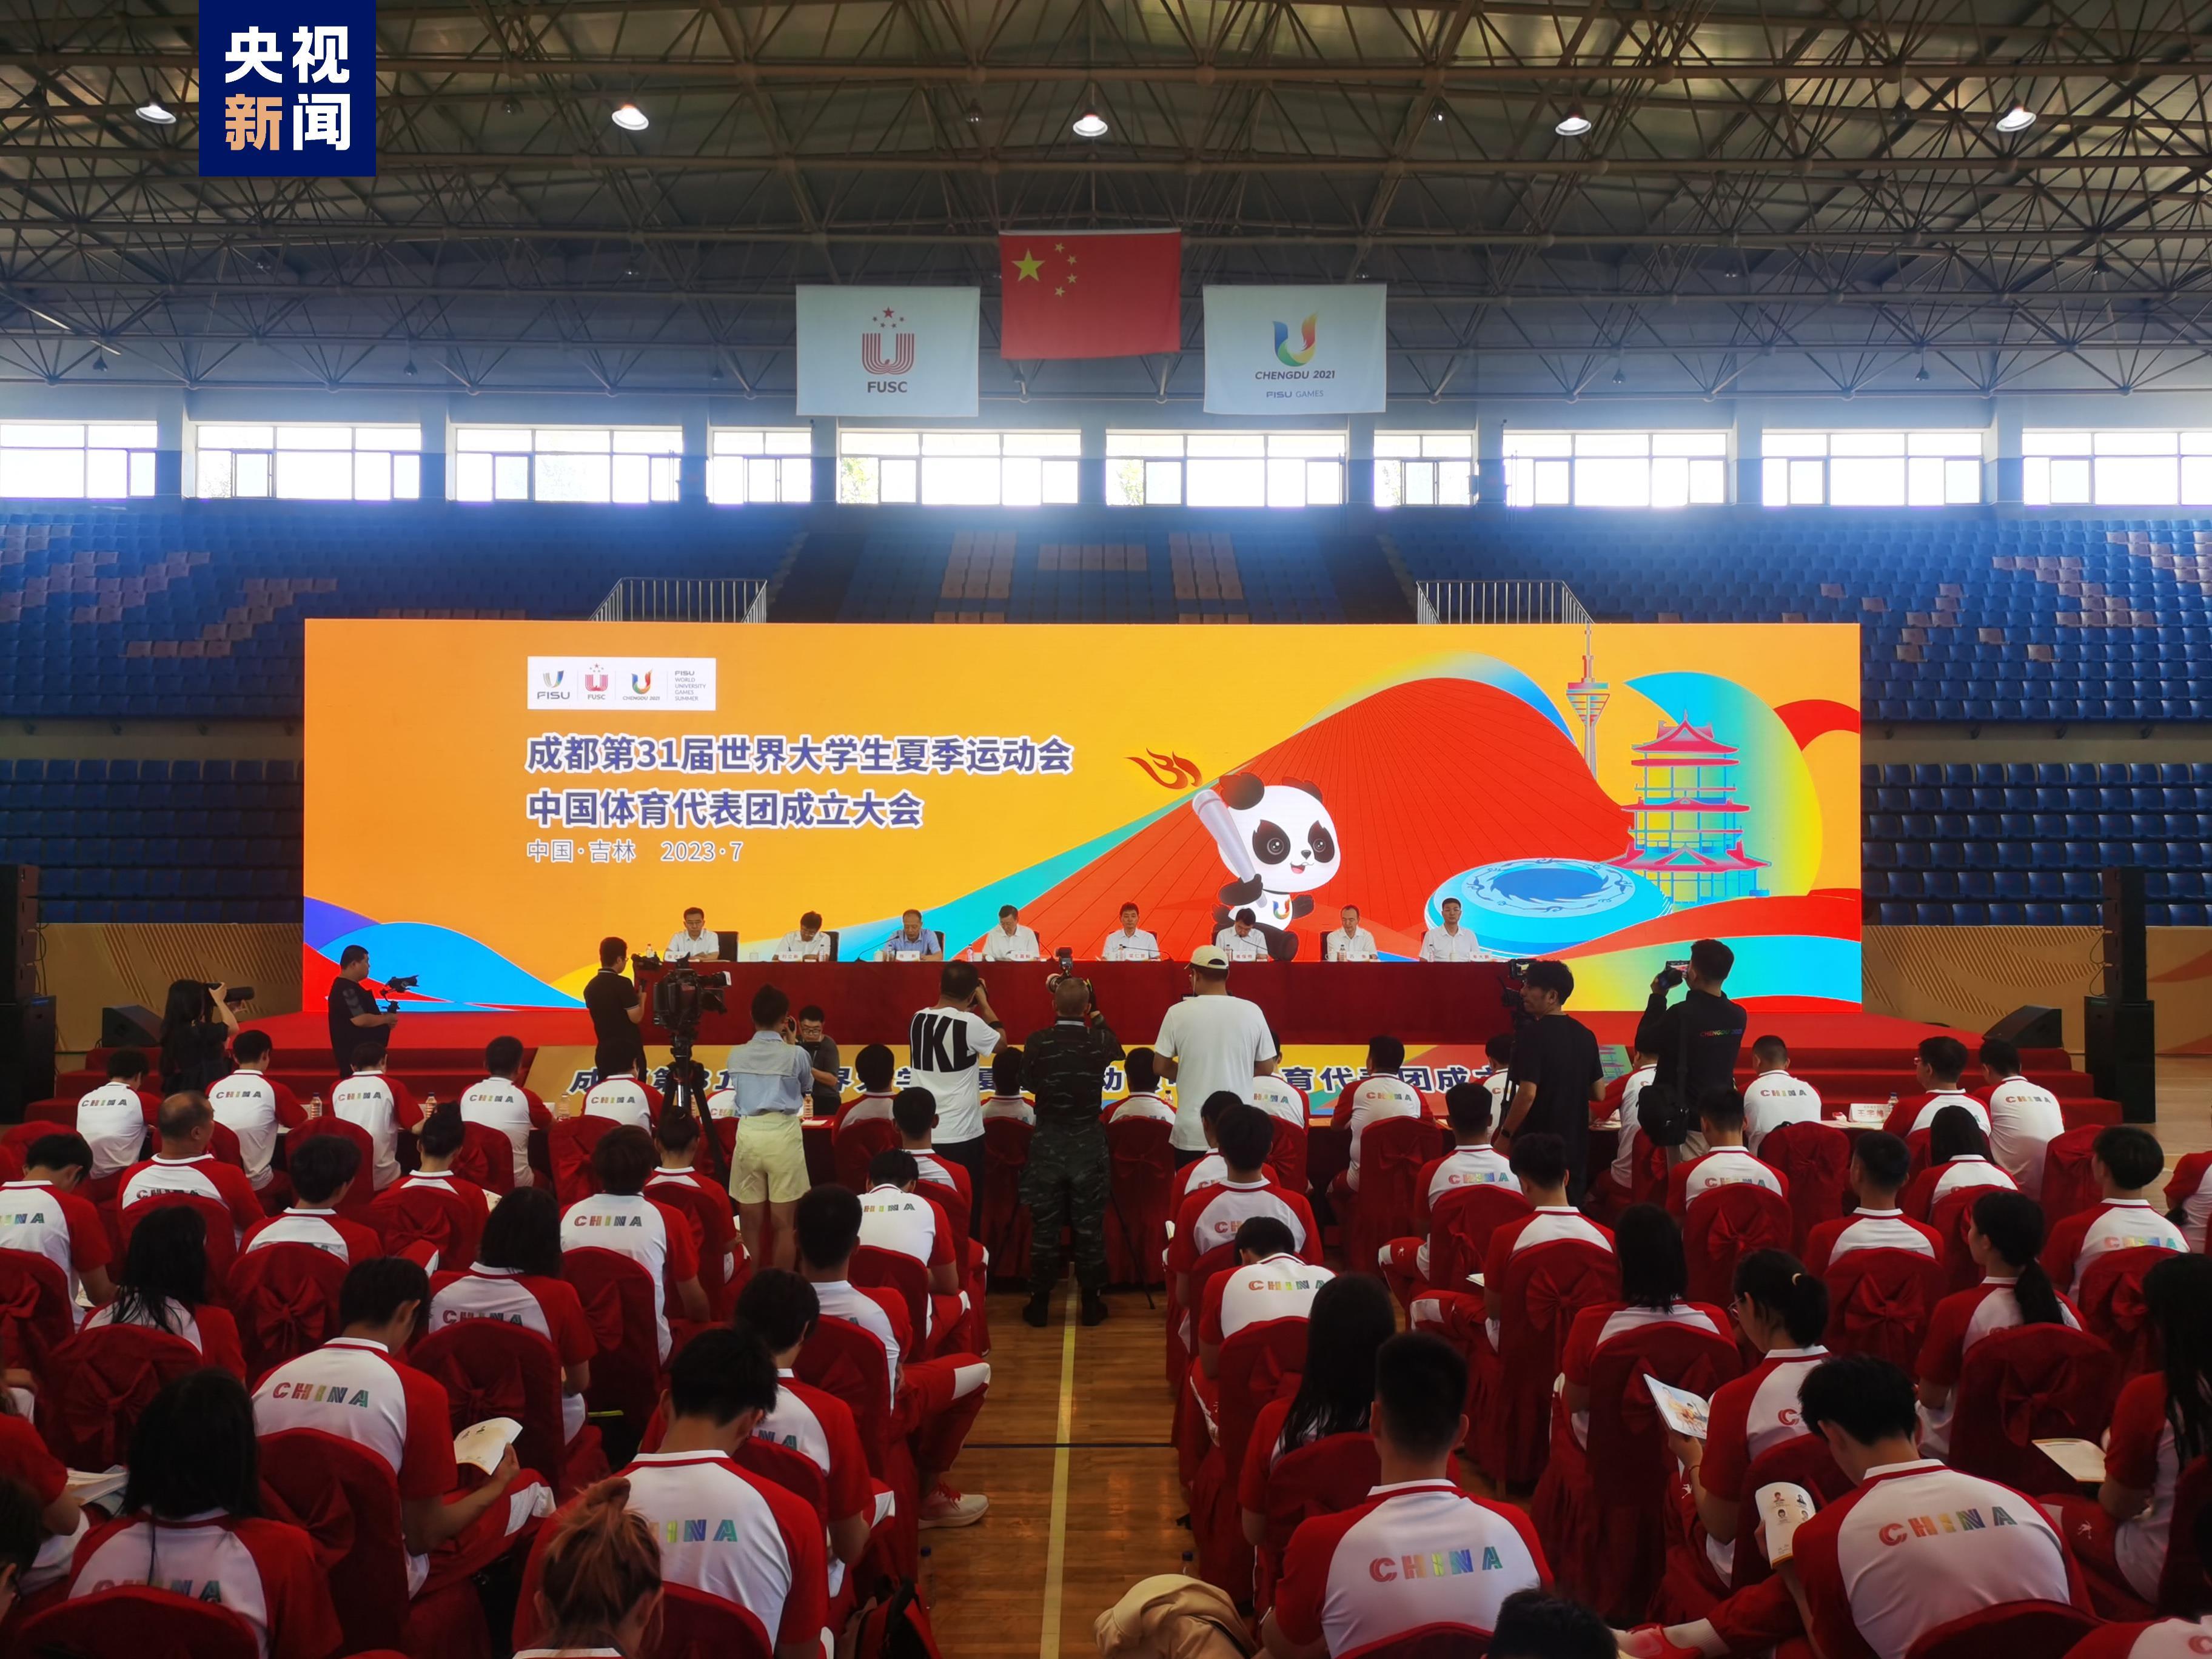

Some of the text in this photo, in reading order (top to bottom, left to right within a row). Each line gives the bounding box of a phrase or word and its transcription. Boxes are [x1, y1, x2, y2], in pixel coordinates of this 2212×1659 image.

[1255, 370, 1335, 380] CHENGDU 2021
[867, 381, 908, 393] FUSC
[526, 736, 1073, 774] 成都第31届世界大学生夏季运动会
[526, 790, 923, 828] 中国体育代表团成立大会
[81, 1098, 127, 1107] CHINA
[338, 1092, 381, 1102] CHINA
[470, 1094, 514, 1103] CHINA
[1254, 1093, 1290, 1104] HINA
[864, 1204, 916, 1212] HINA
[574, 1215, 642, 1227] CHINA
[273, 1382, 369, 1408] CHINA
[1879, 1506, 2018, 1546] CHINA
[1369, 1546, 1503, 1583] CHINA
